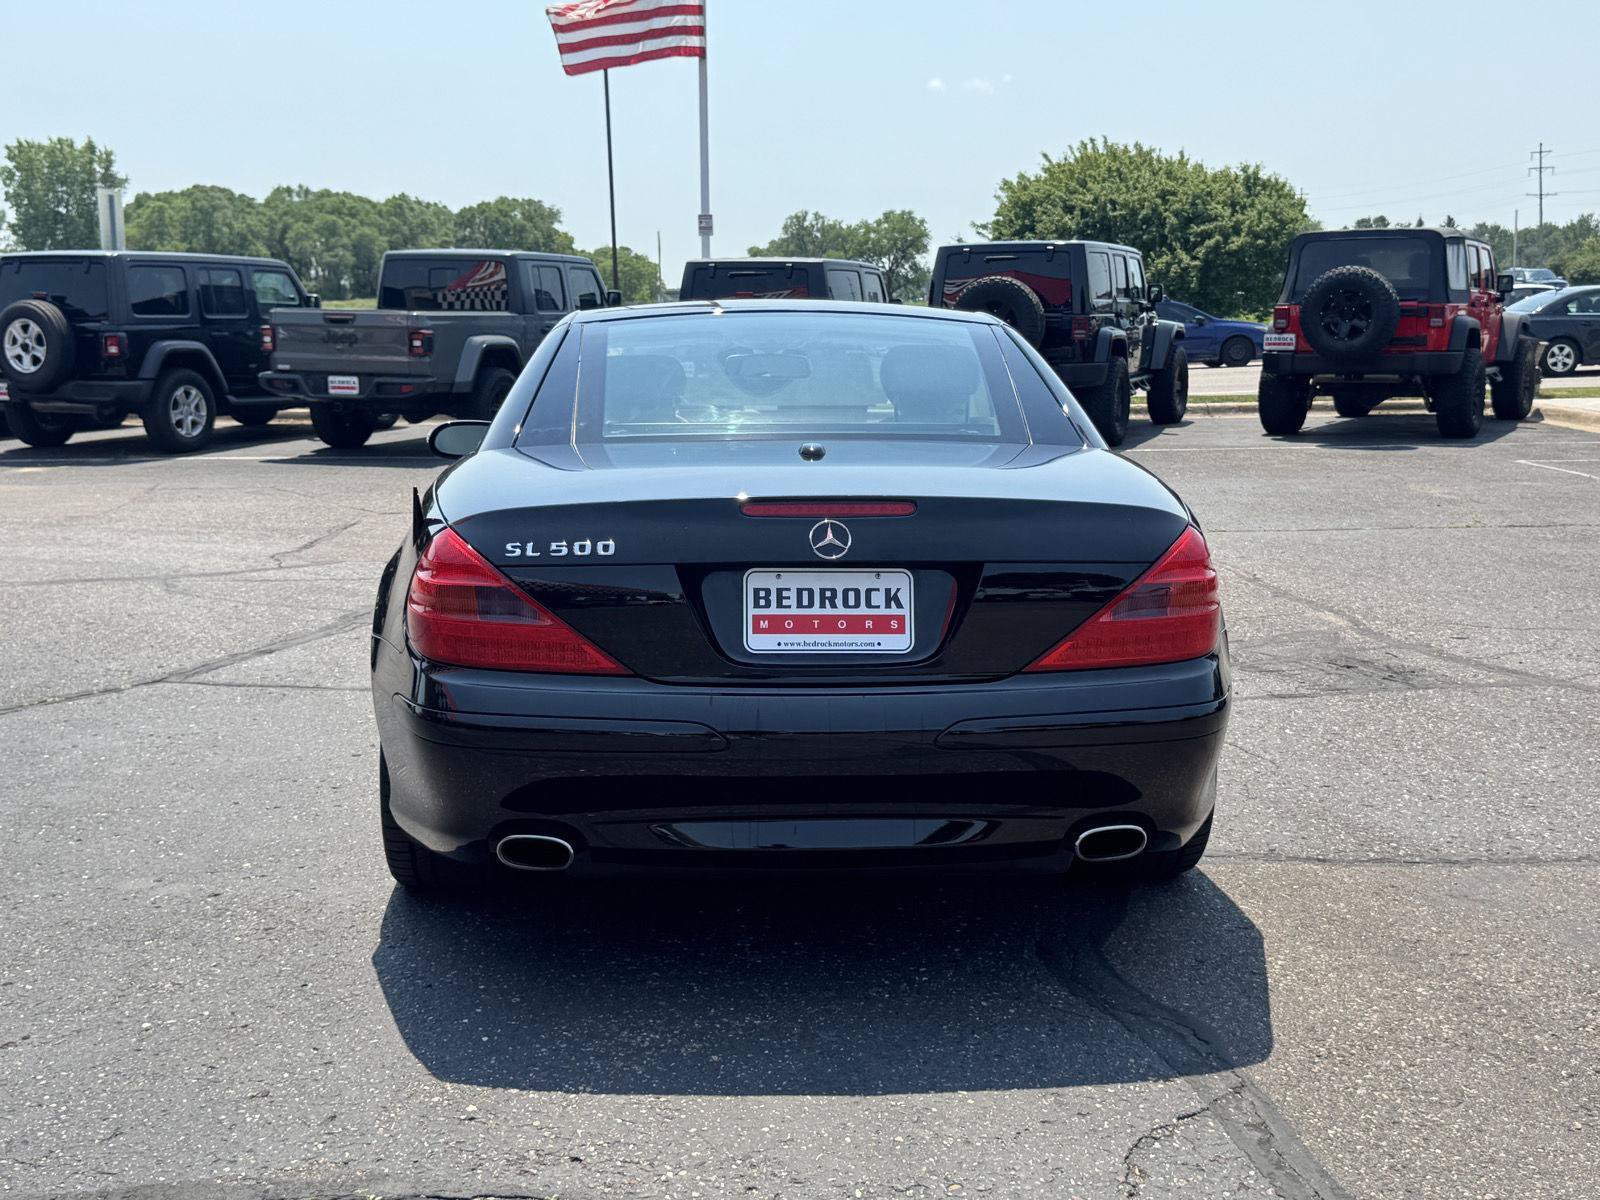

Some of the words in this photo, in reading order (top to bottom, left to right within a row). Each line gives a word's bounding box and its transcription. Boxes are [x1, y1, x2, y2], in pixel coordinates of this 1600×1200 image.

[505, 541, 541, 557] SL
[549, 539, 616, 557] 500
[752, 587, 905, 610] BEDROCK
[759, 619, 899, 629] MOTORS
[783, 640, 876, 648] www.bedrockmotors.com
